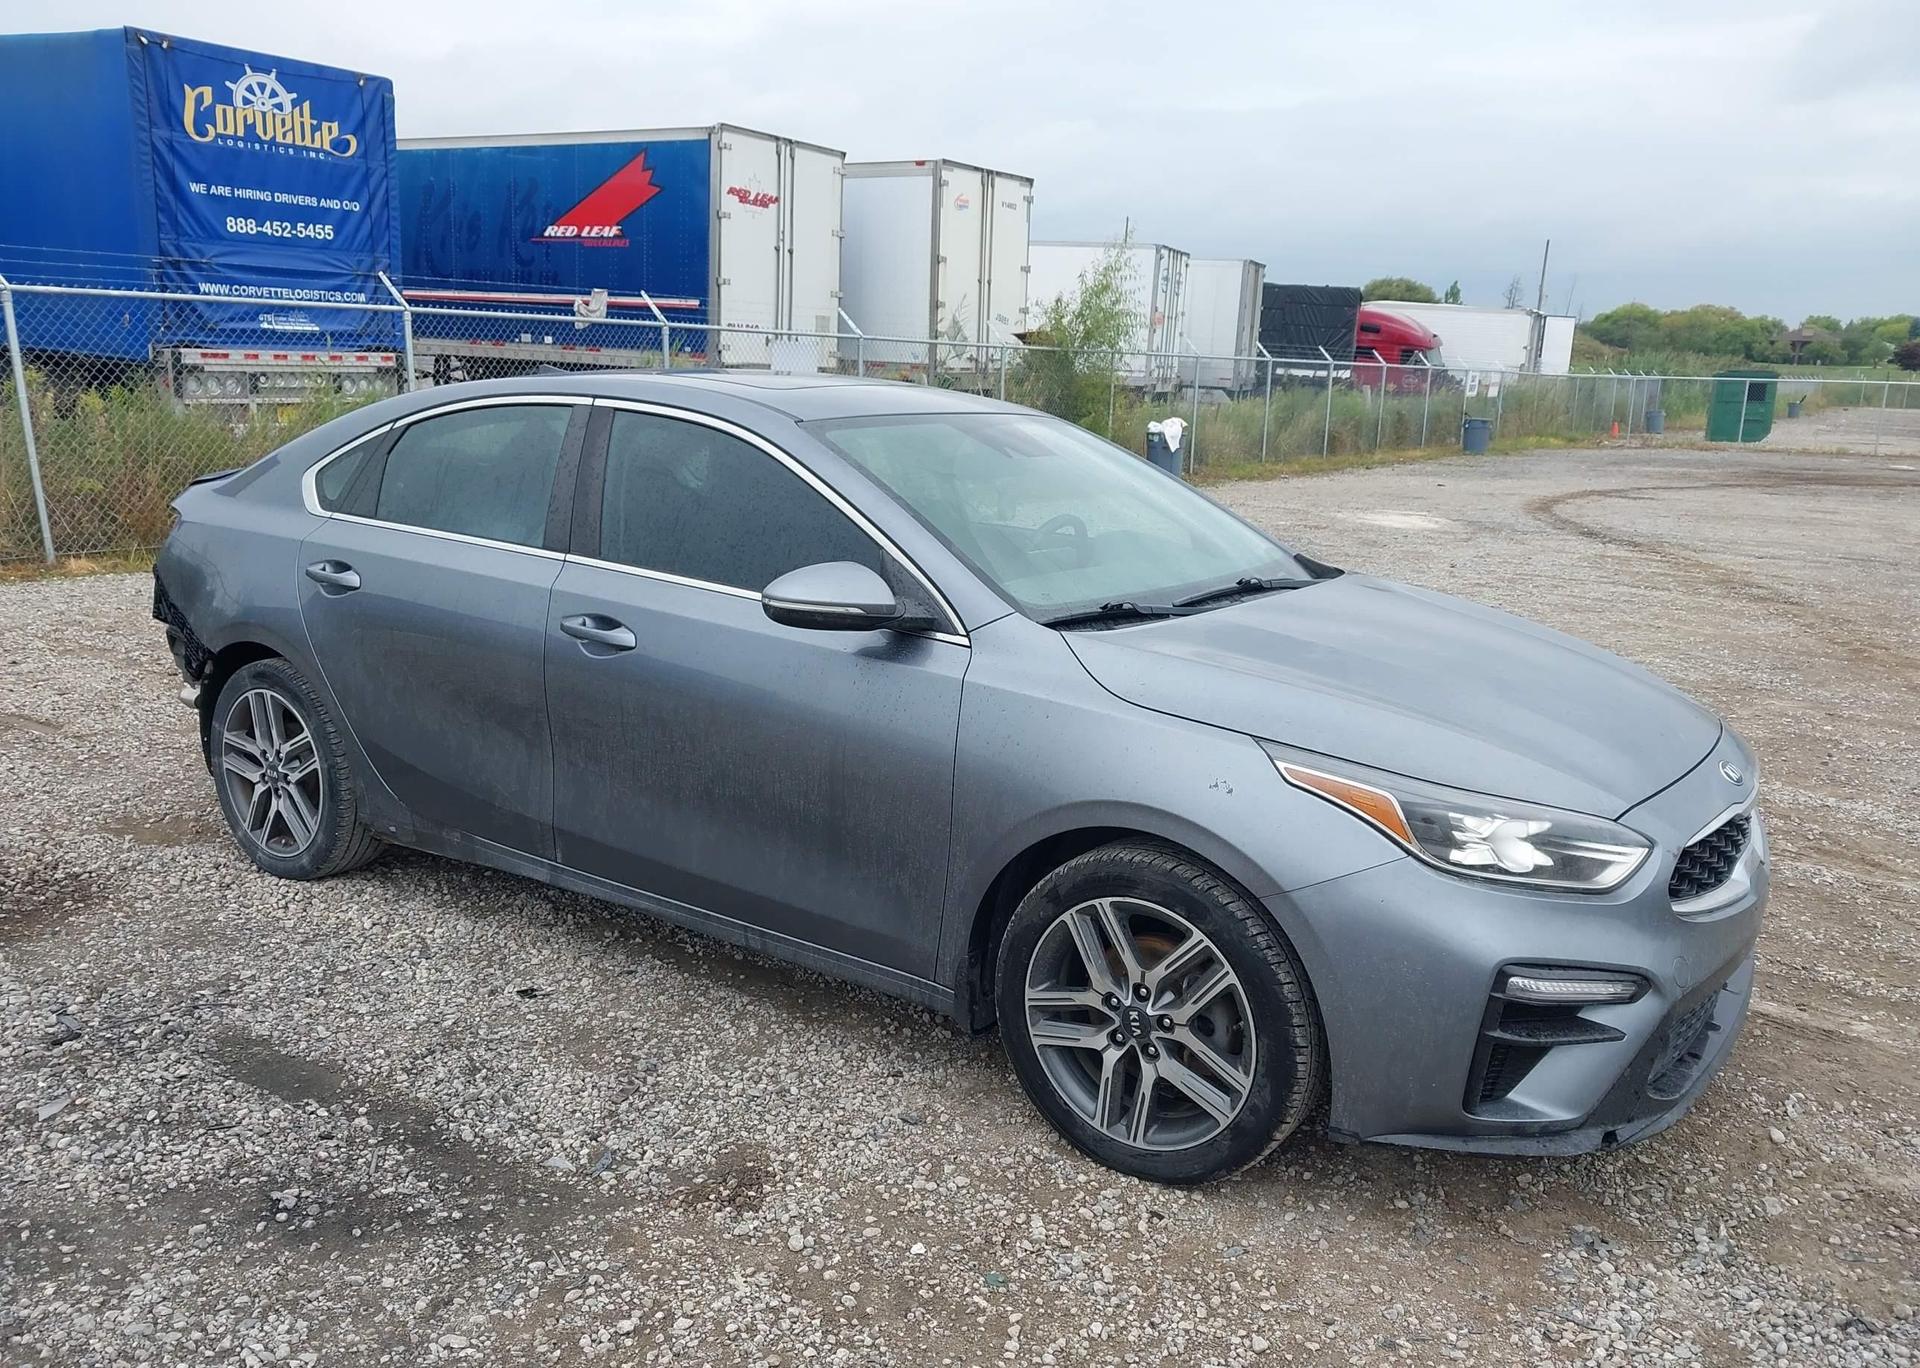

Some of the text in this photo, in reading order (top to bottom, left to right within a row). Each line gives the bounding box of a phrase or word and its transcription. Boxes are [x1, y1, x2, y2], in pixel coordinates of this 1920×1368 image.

[183, 83, 358, 158] Corvette
[217, 138, 294, 155] LOGISTICS
[189, 182, 208, 194] WE
[209, 185, 232, 197] ARE
[234, 188, 272, 202] HIRING
[274, 192, 318, 207] DRIVERS
[319, 198, 341, 210] AND
[226, 216, 334, 240] 888-452-5455
[543, 225, 622, 238] RED LEAF
[198, 282, 366, 302] WWW.CORVETTELOGISTICS.COM
[1129, 1011, 1141, 1037] KIA
